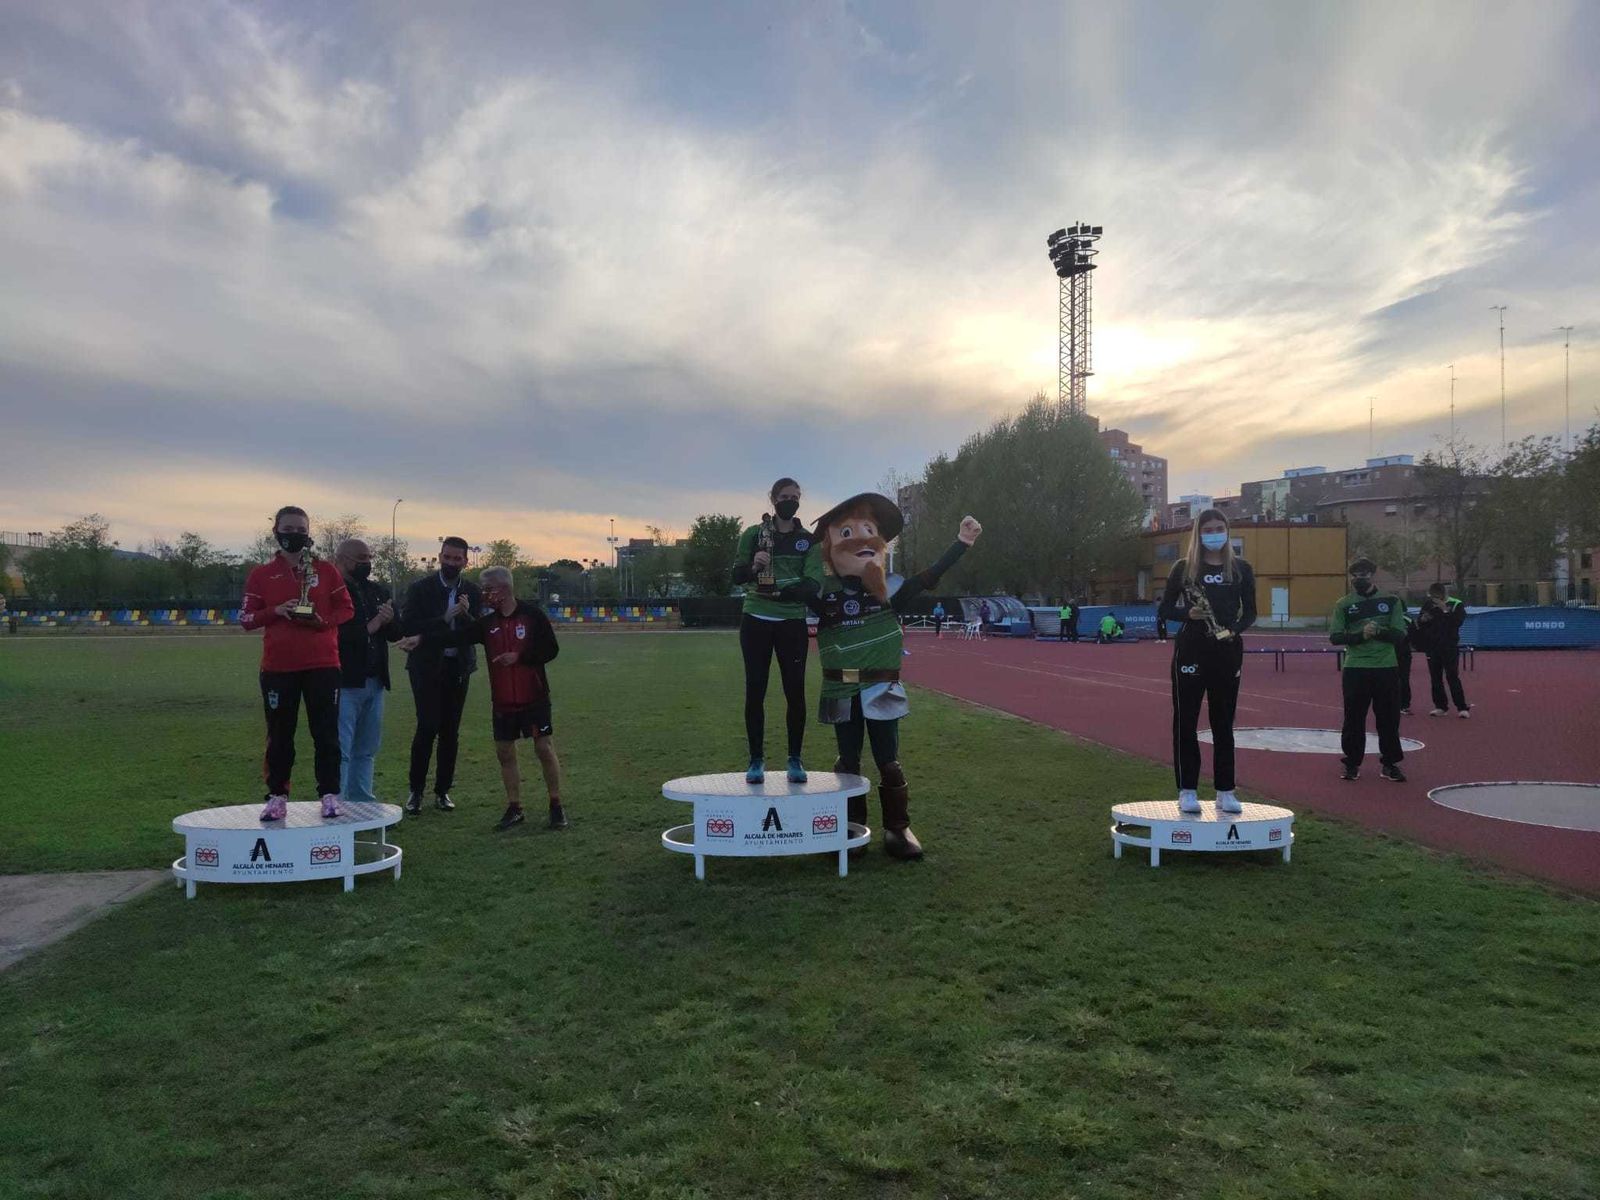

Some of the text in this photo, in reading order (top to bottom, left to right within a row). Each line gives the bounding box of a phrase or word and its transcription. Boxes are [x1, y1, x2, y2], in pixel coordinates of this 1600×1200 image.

[1525, 621, 1565, 629] MONDO
[744, 832, 767, 840] ALCALÁ
[744, 838, 804, 846] AYUNTAMIENTO
[232, 862, 255, 870] ALCALÁ
